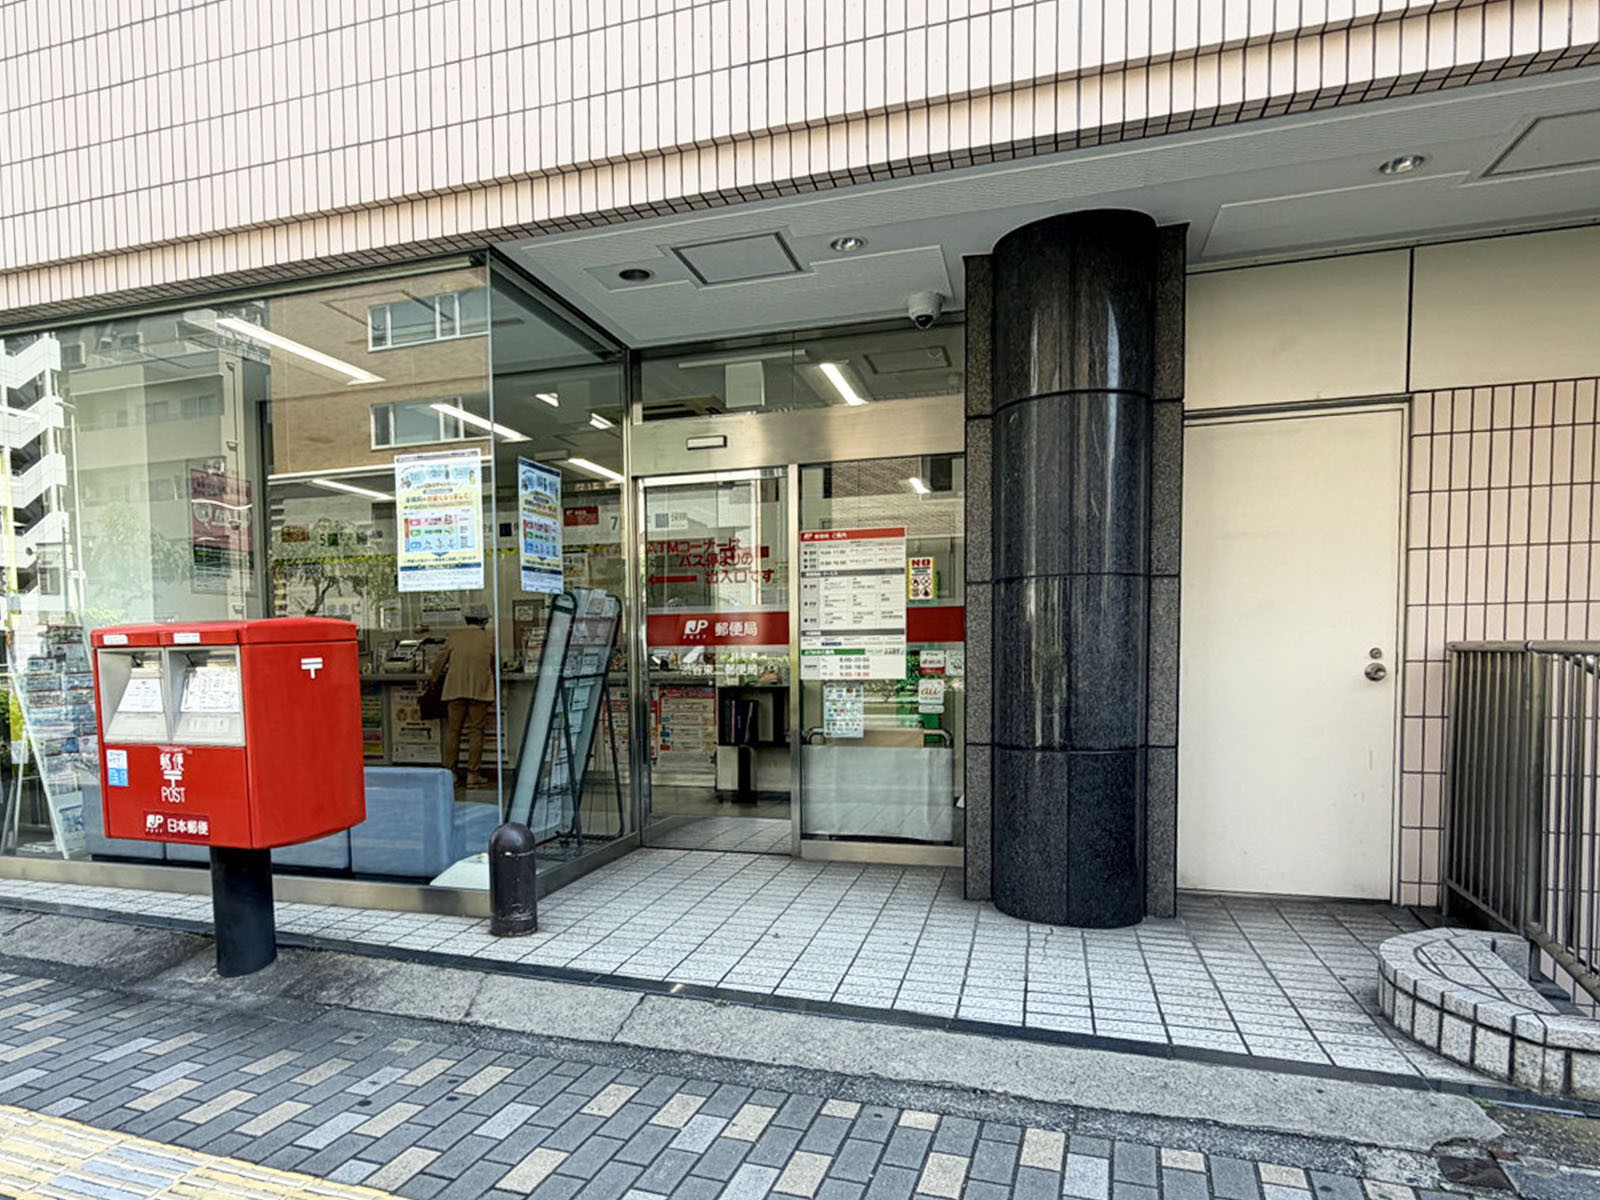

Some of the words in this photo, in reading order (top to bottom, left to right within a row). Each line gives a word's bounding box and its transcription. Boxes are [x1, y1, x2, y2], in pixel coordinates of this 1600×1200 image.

[715, 621, 758, 637] 郵便局
[921, 687, 940, 696] au
[160, 753, 184, 771] 郵便
[161, 786, 186, 803] POST
[167, 818, 209, 835] 日本郵便
